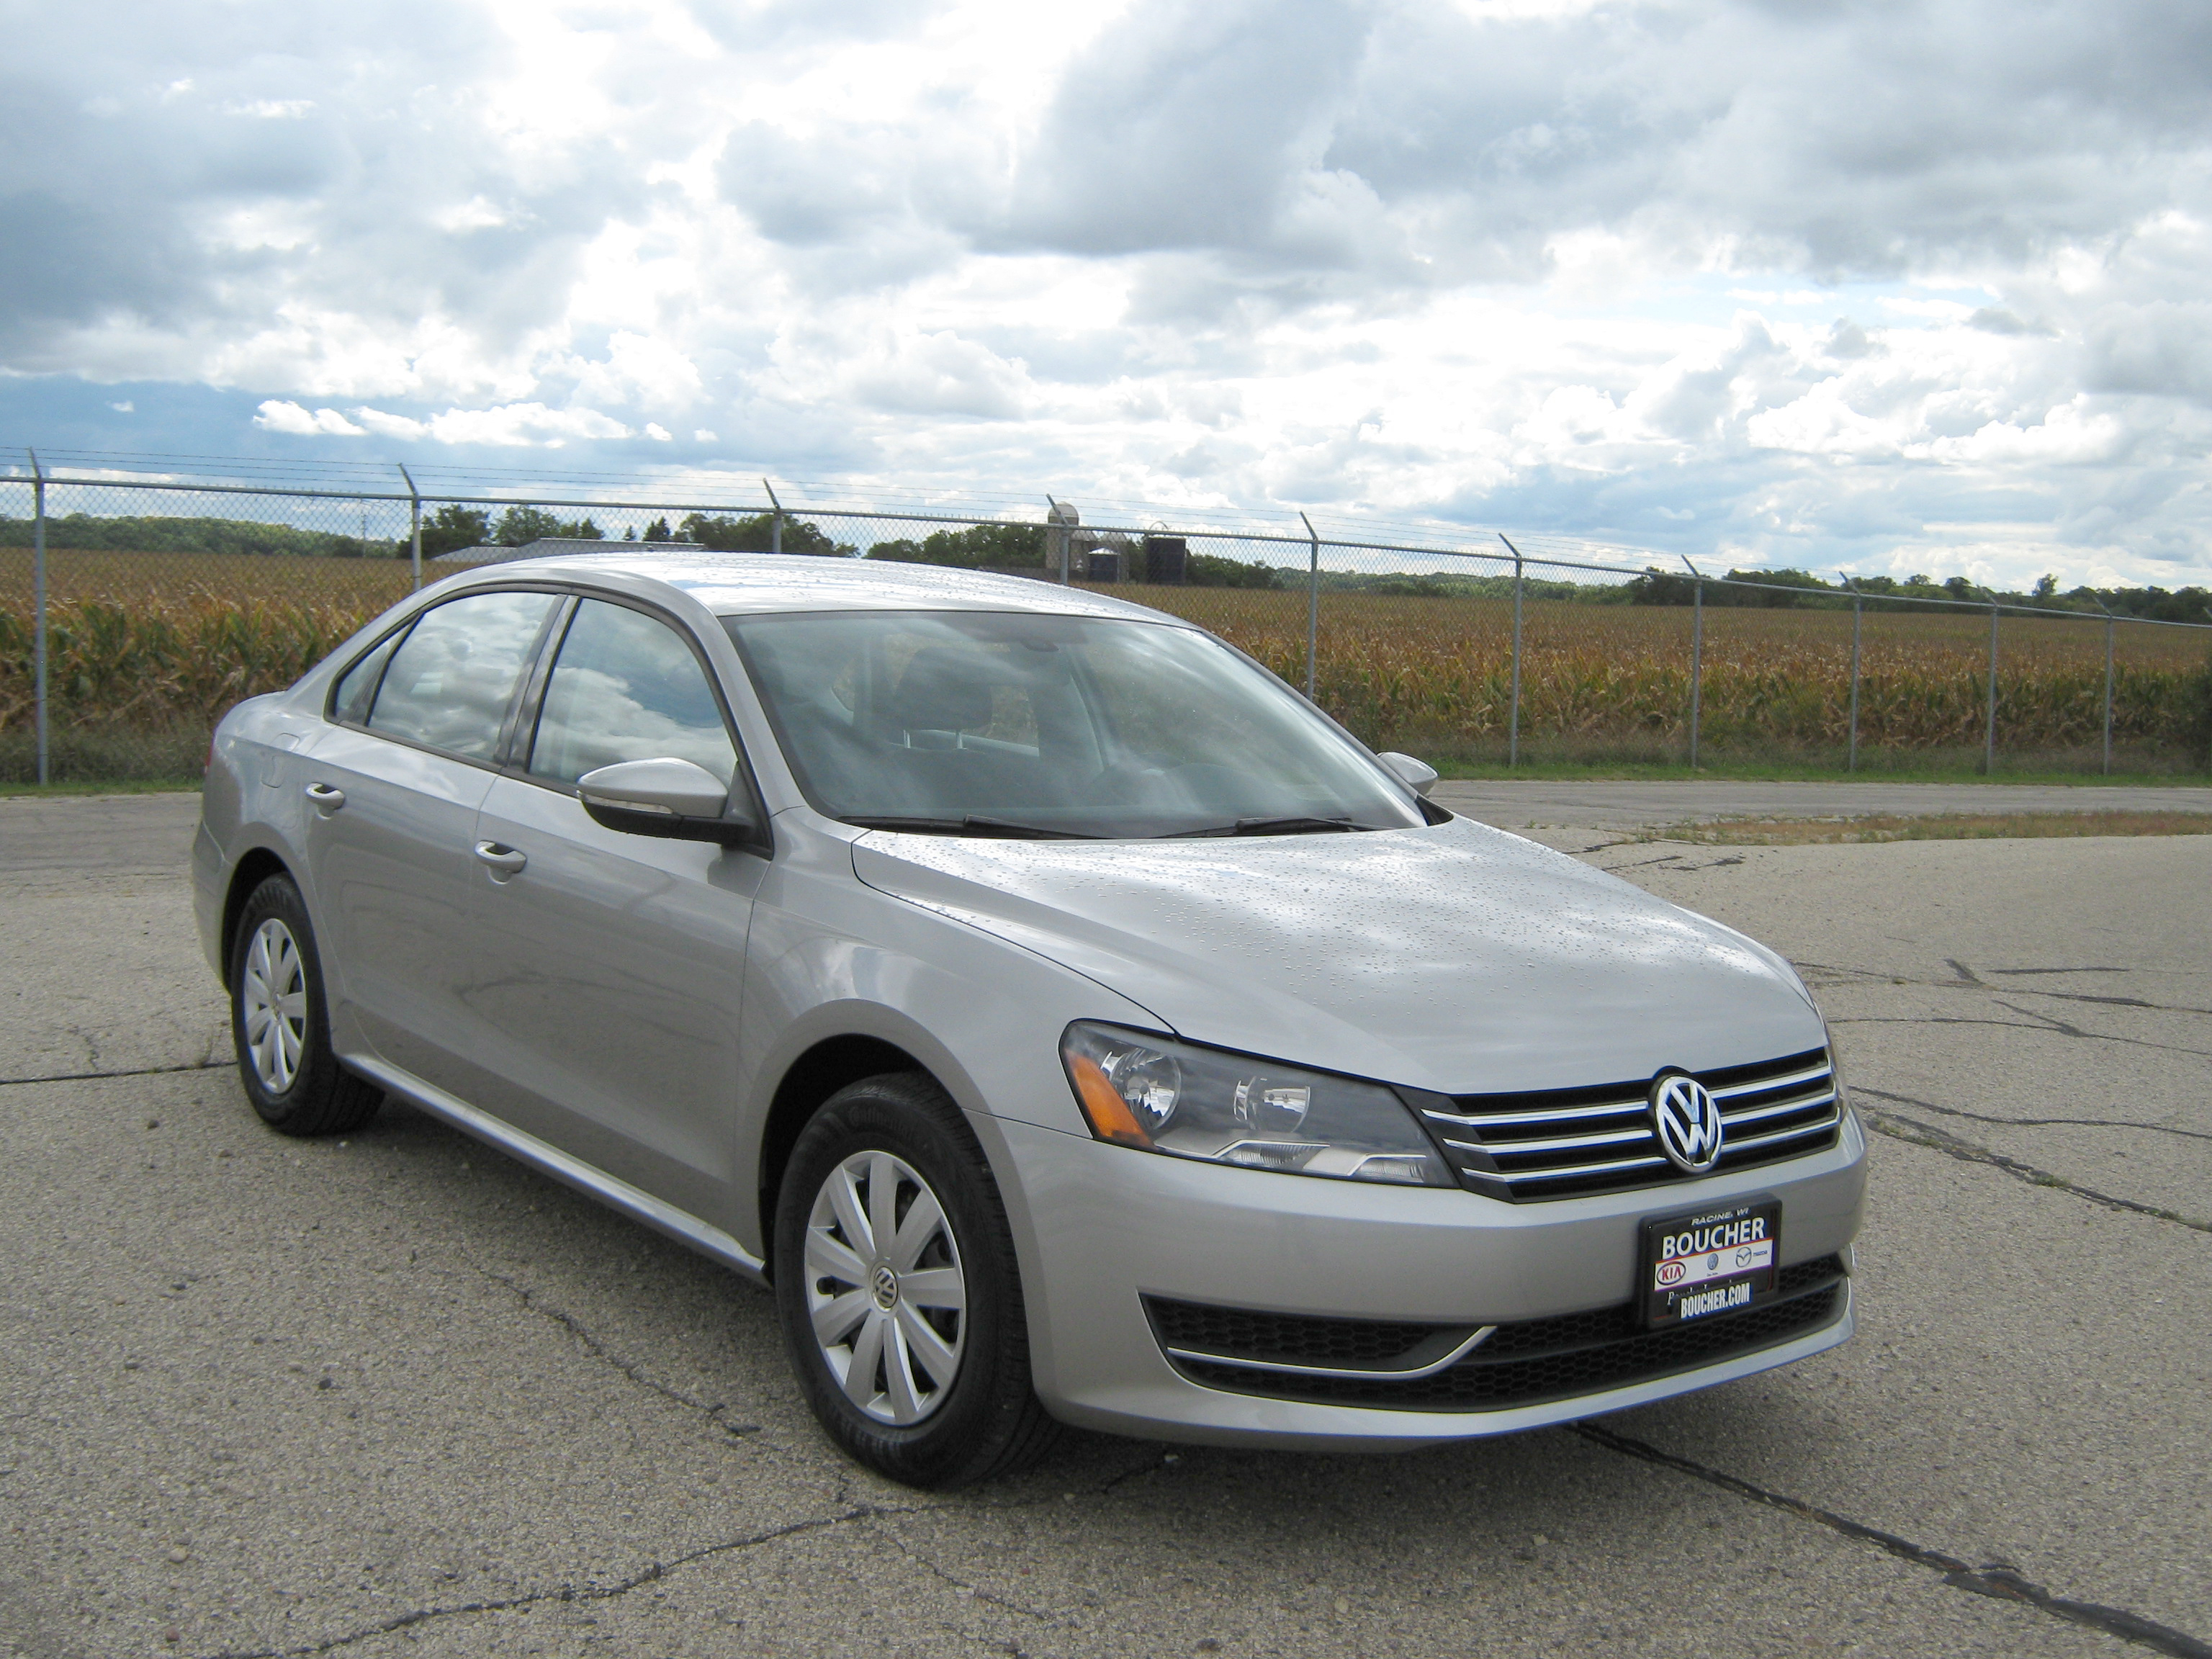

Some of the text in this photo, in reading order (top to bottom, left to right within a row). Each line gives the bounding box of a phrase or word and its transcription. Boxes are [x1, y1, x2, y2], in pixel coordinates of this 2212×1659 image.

[1658, 1078, 1720, 1167] VW
[1736, 1207, 1750, 1217] WI
[1663, 1217, 1765, 1260] BOUCHER
[1661, 1266, 1681, 1281] KIA
[1681, 1282, 1750, 1319] BOUCHER.COM
